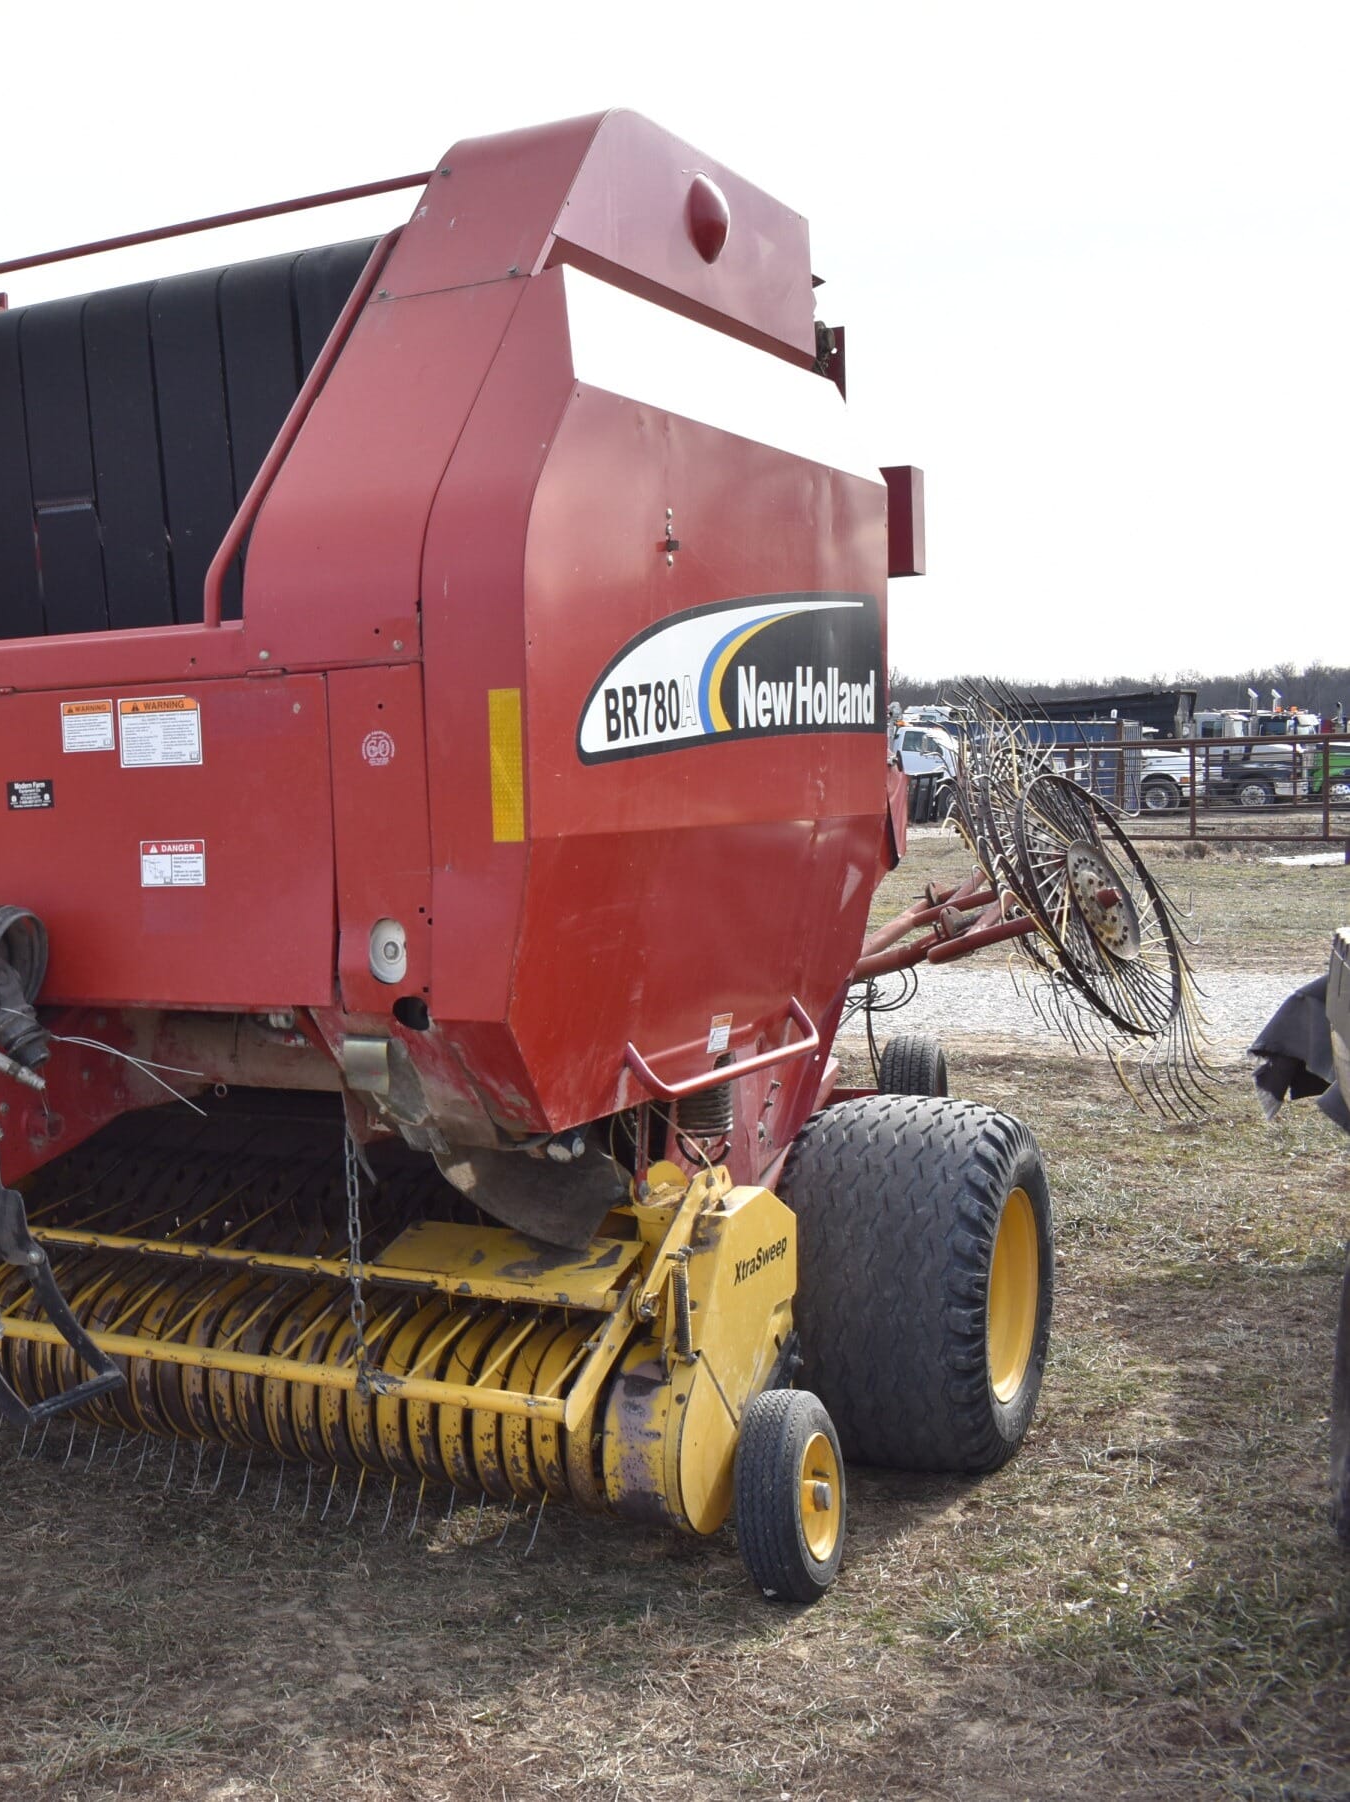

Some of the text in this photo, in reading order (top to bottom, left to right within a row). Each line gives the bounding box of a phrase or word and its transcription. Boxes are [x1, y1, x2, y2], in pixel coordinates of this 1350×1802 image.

[74, 703, 107, 712] WARNING
[143, 699, 184, 711] WARNING
[604, 675, 697, 742] BR780A
[737, 665, 875, 728] New Holland
[161, 843, 195, 853] DANGER
[734, 1236, 787, 1287] XtraSweep
